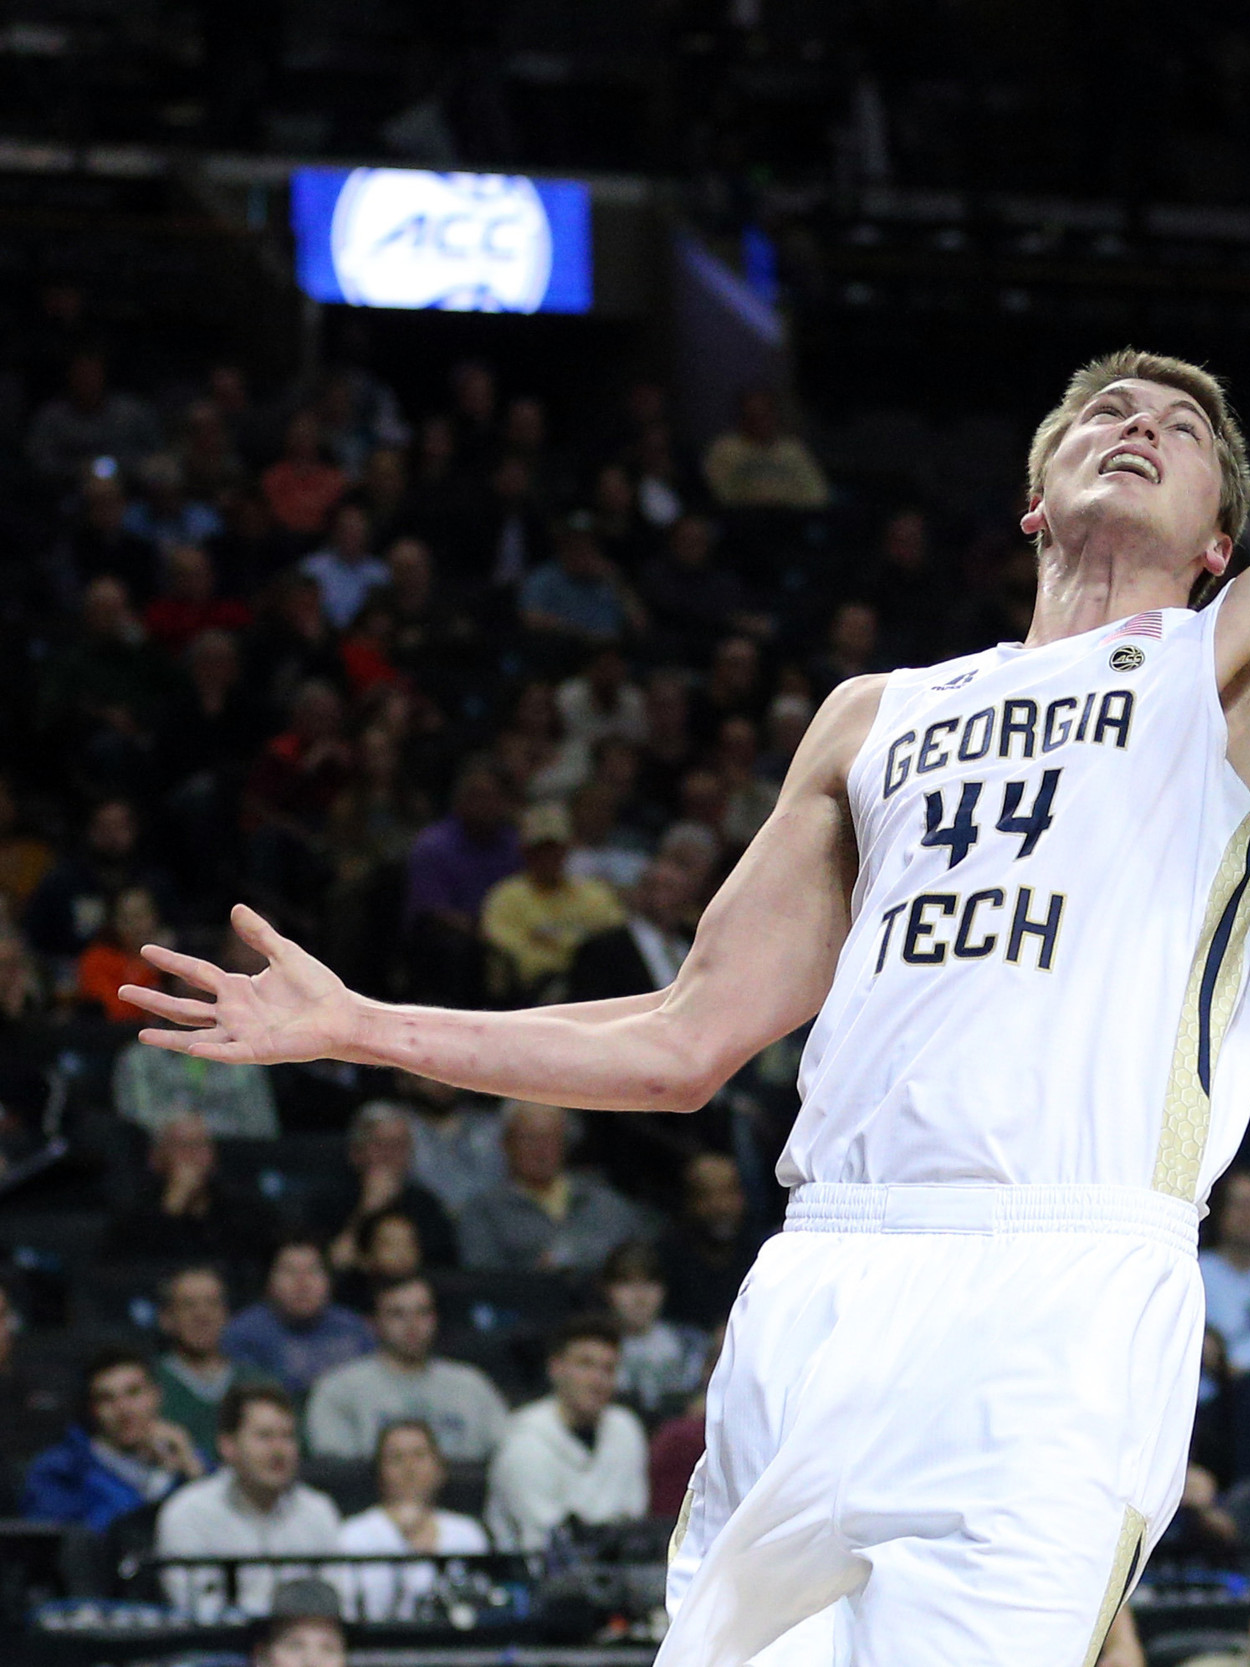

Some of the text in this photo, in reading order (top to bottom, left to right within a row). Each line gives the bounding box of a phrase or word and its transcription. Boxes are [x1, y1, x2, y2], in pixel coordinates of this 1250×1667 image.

[370, 211, 523, 262] ACC
[883, 689, 1138, 801] GEORGIA
[920, 767, 1065, 872] 44
[872, 884, 1068, 979] TECH
